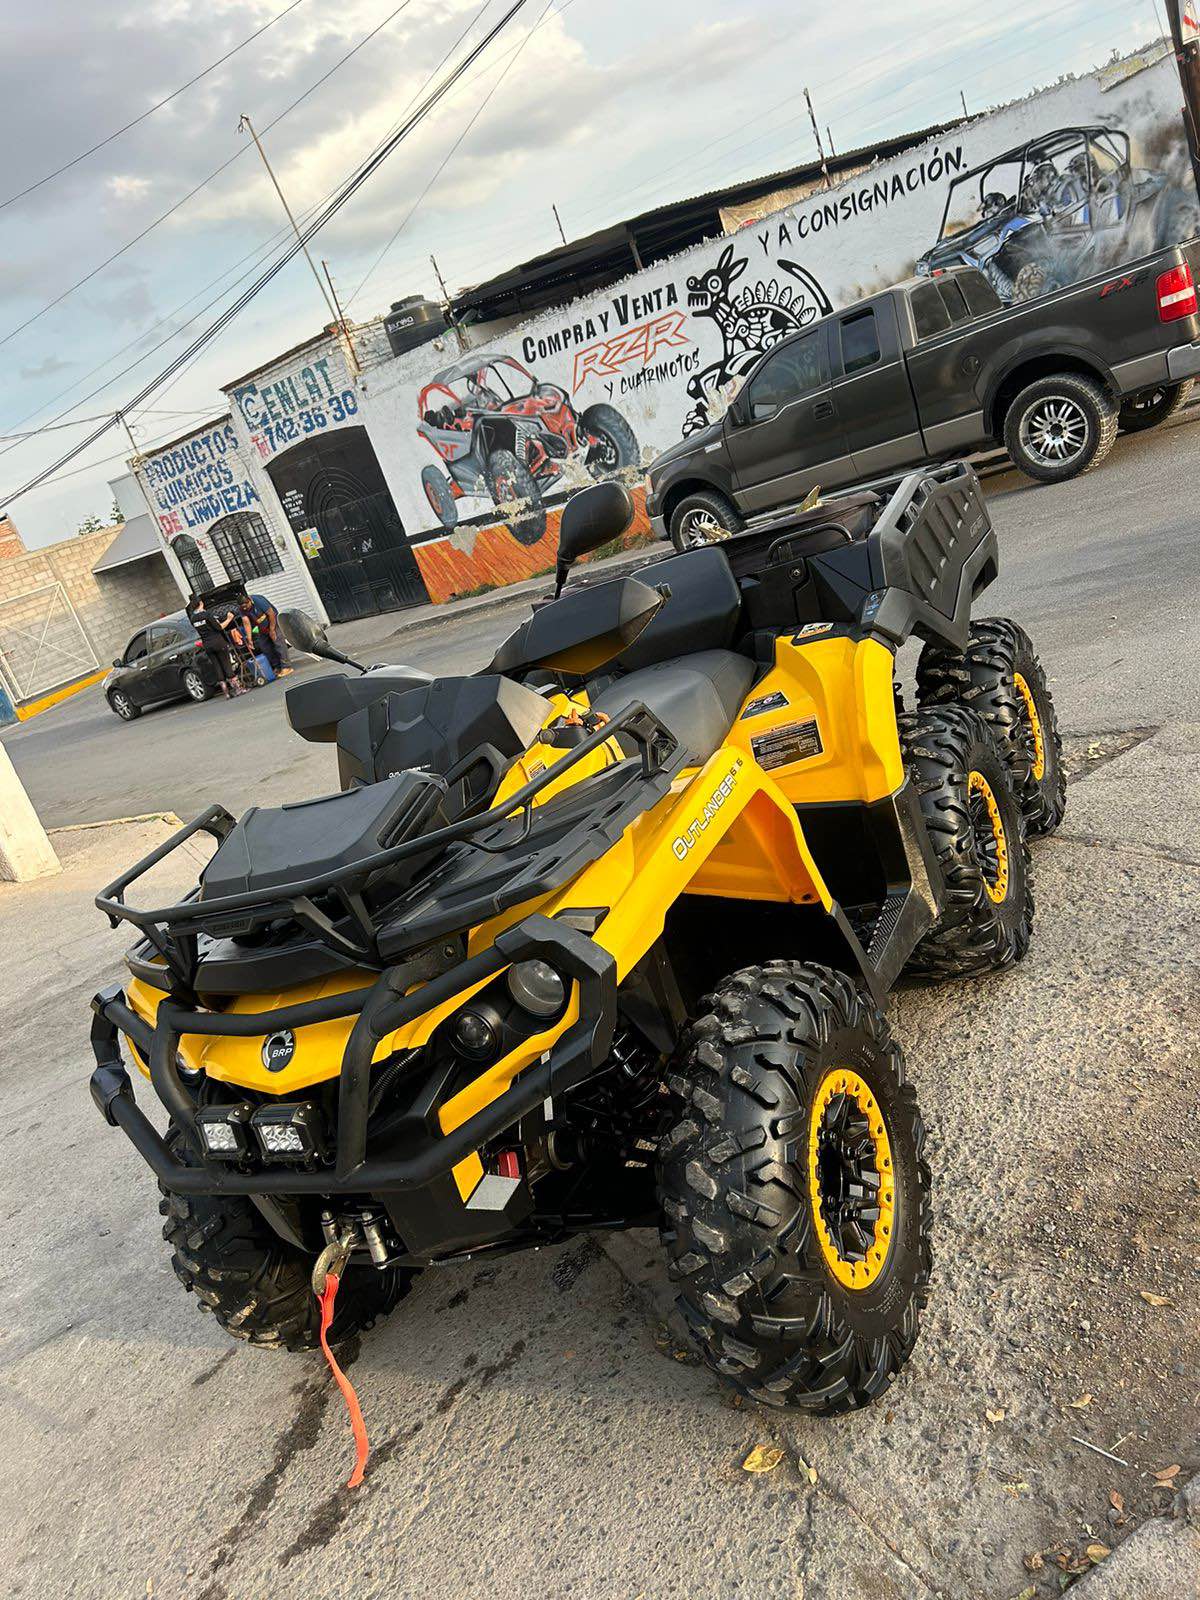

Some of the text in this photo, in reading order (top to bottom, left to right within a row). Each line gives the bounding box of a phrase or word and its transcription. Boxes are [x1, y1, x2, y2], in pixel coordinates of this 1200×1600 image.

[757, 147, 968, 255] Y A CONSIGNACIÓN.
[522, 283, 679, 364] COMPRA Y VENTA
[572, 310, 690, 396] RZR
[233, 358, 334, 432] CENLAT
[604, 348, 700, 400] Y CUATRIMOTOS
[144, 424, 239, 487] PRODUCTOS
[159, 510, 183, 534] DE
[181, 480, 260, 528] LIMPIEZA
[672, 773, 737, 861] OUTLANDER
[272, 1047, 293, 1058] BRP
